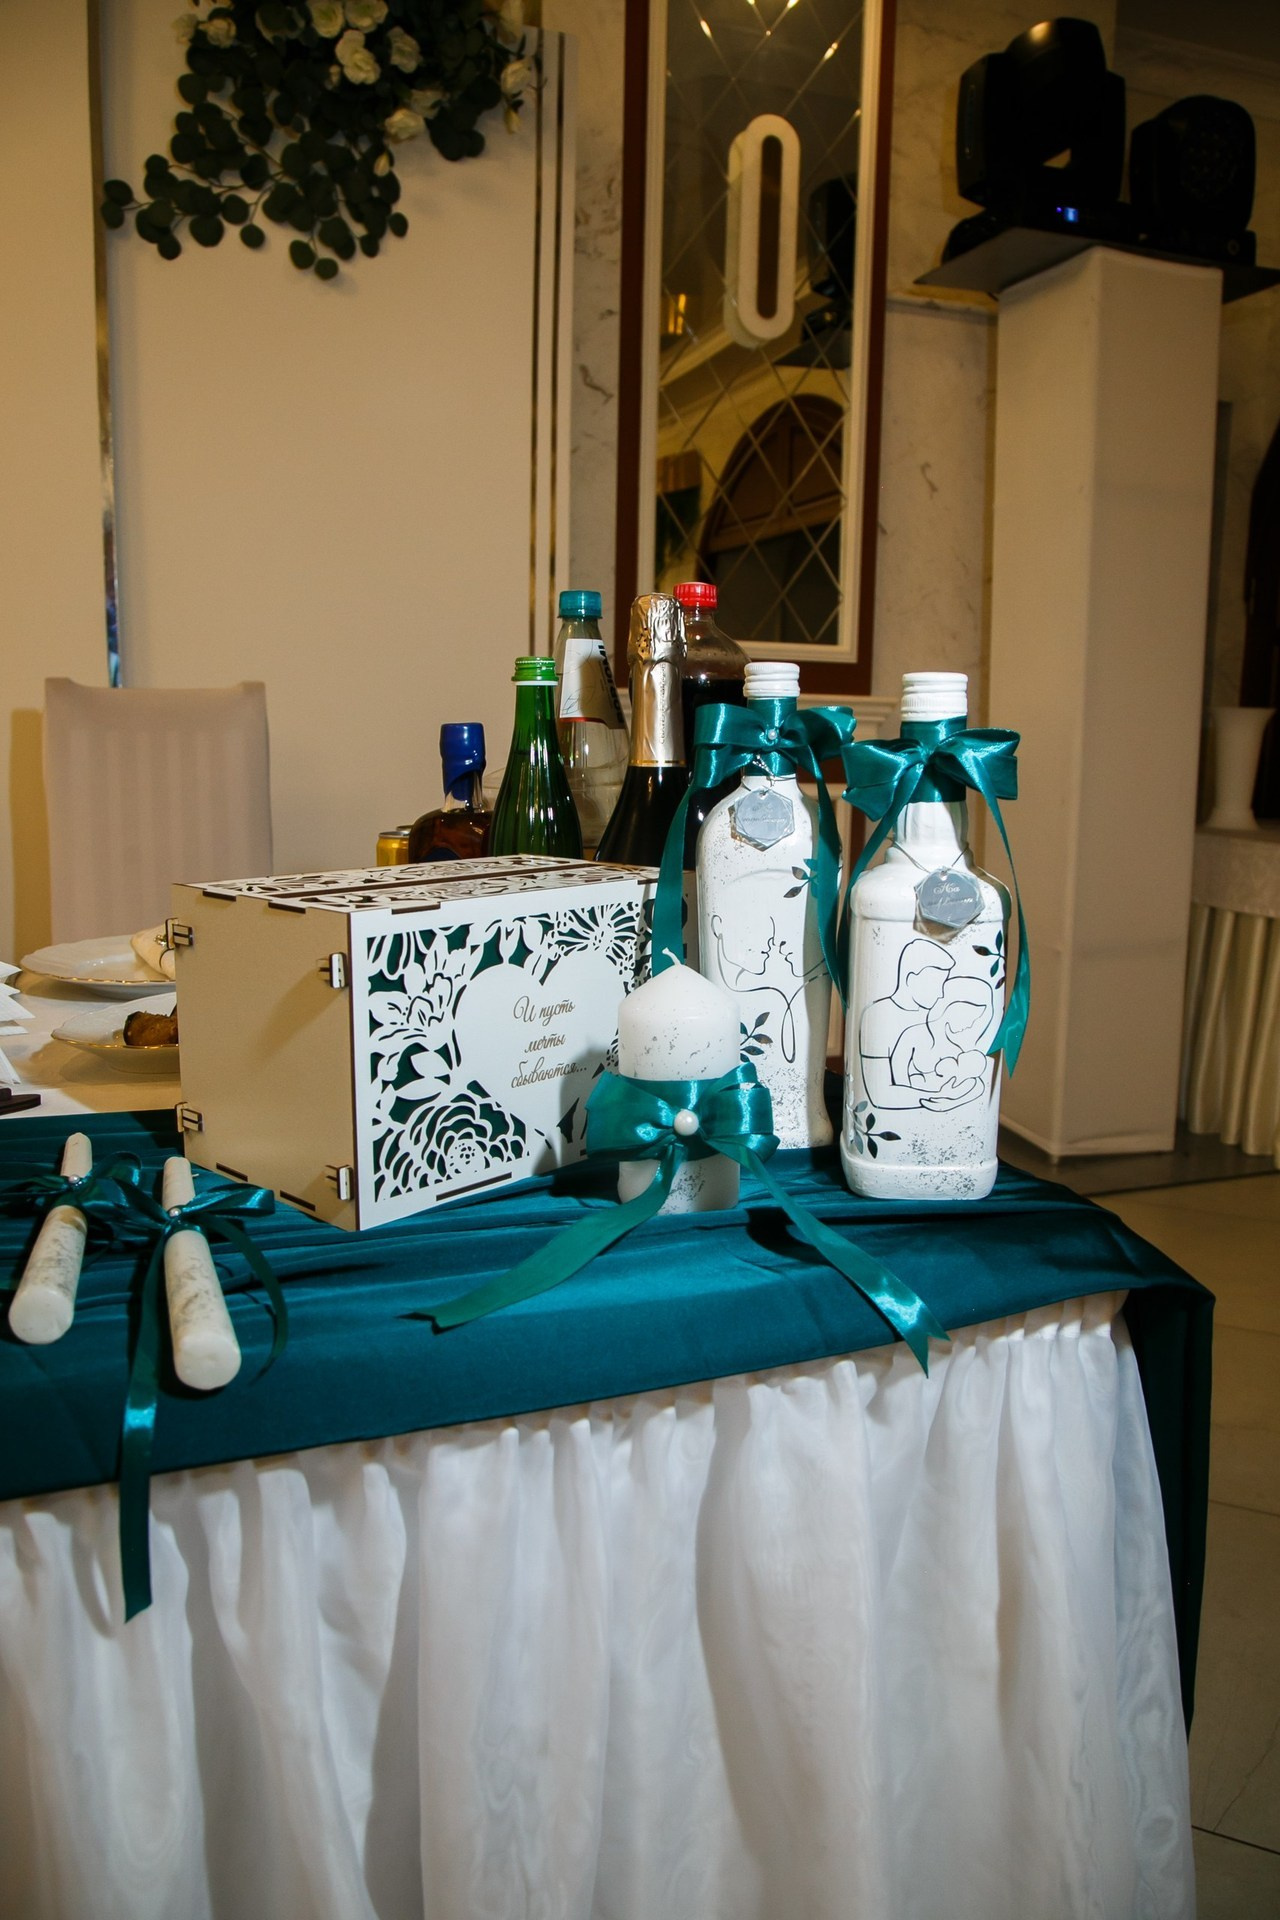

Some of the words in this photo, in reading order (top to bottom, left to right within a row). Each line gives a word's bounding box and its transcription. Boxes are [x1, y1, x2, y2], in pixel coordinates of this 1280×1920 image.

[513, 995, 537, 1023] И
[538, 999, 576, 1027] пусть
[524, 1033, 566, 1054] мечты
[510, 1056, 588, 1089] сбываются...
